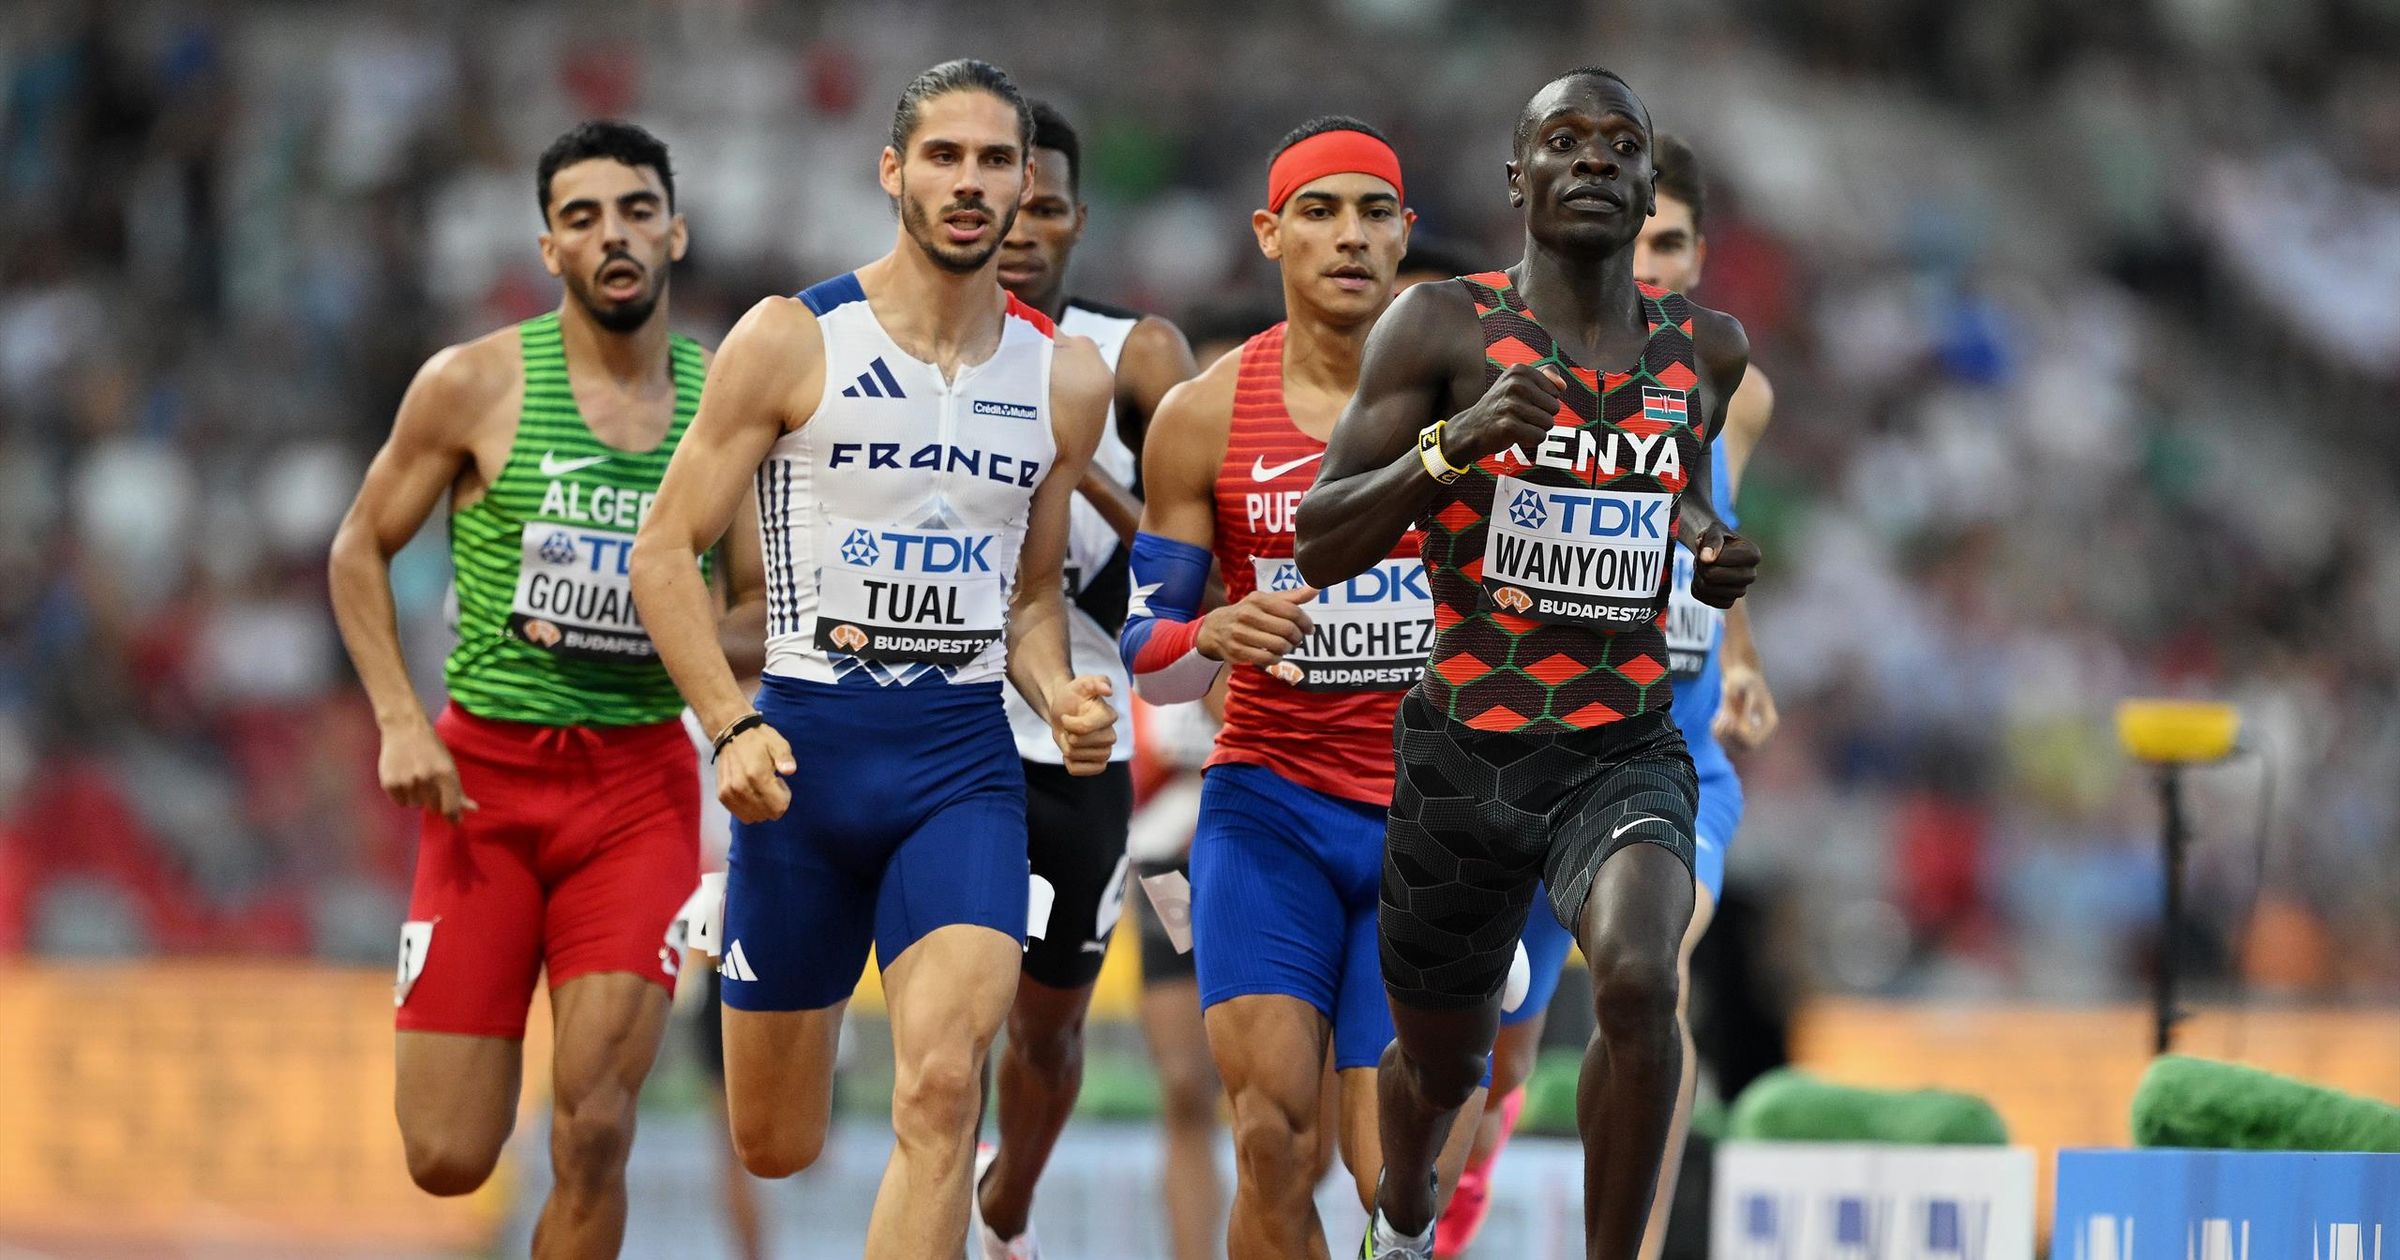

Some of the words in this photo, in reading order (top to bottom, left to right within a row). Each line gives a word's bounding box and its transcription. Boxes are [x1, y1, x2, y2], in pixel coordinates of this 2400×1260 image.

[829, 443, 1040, 488] FRANCE
[1549, 494, 1663, 539] TDK
[881, 532, 994, 573] TDK
[1495, 532, 1660, 592] WANYONYI
[863, 580, 965, 625] TUAL
